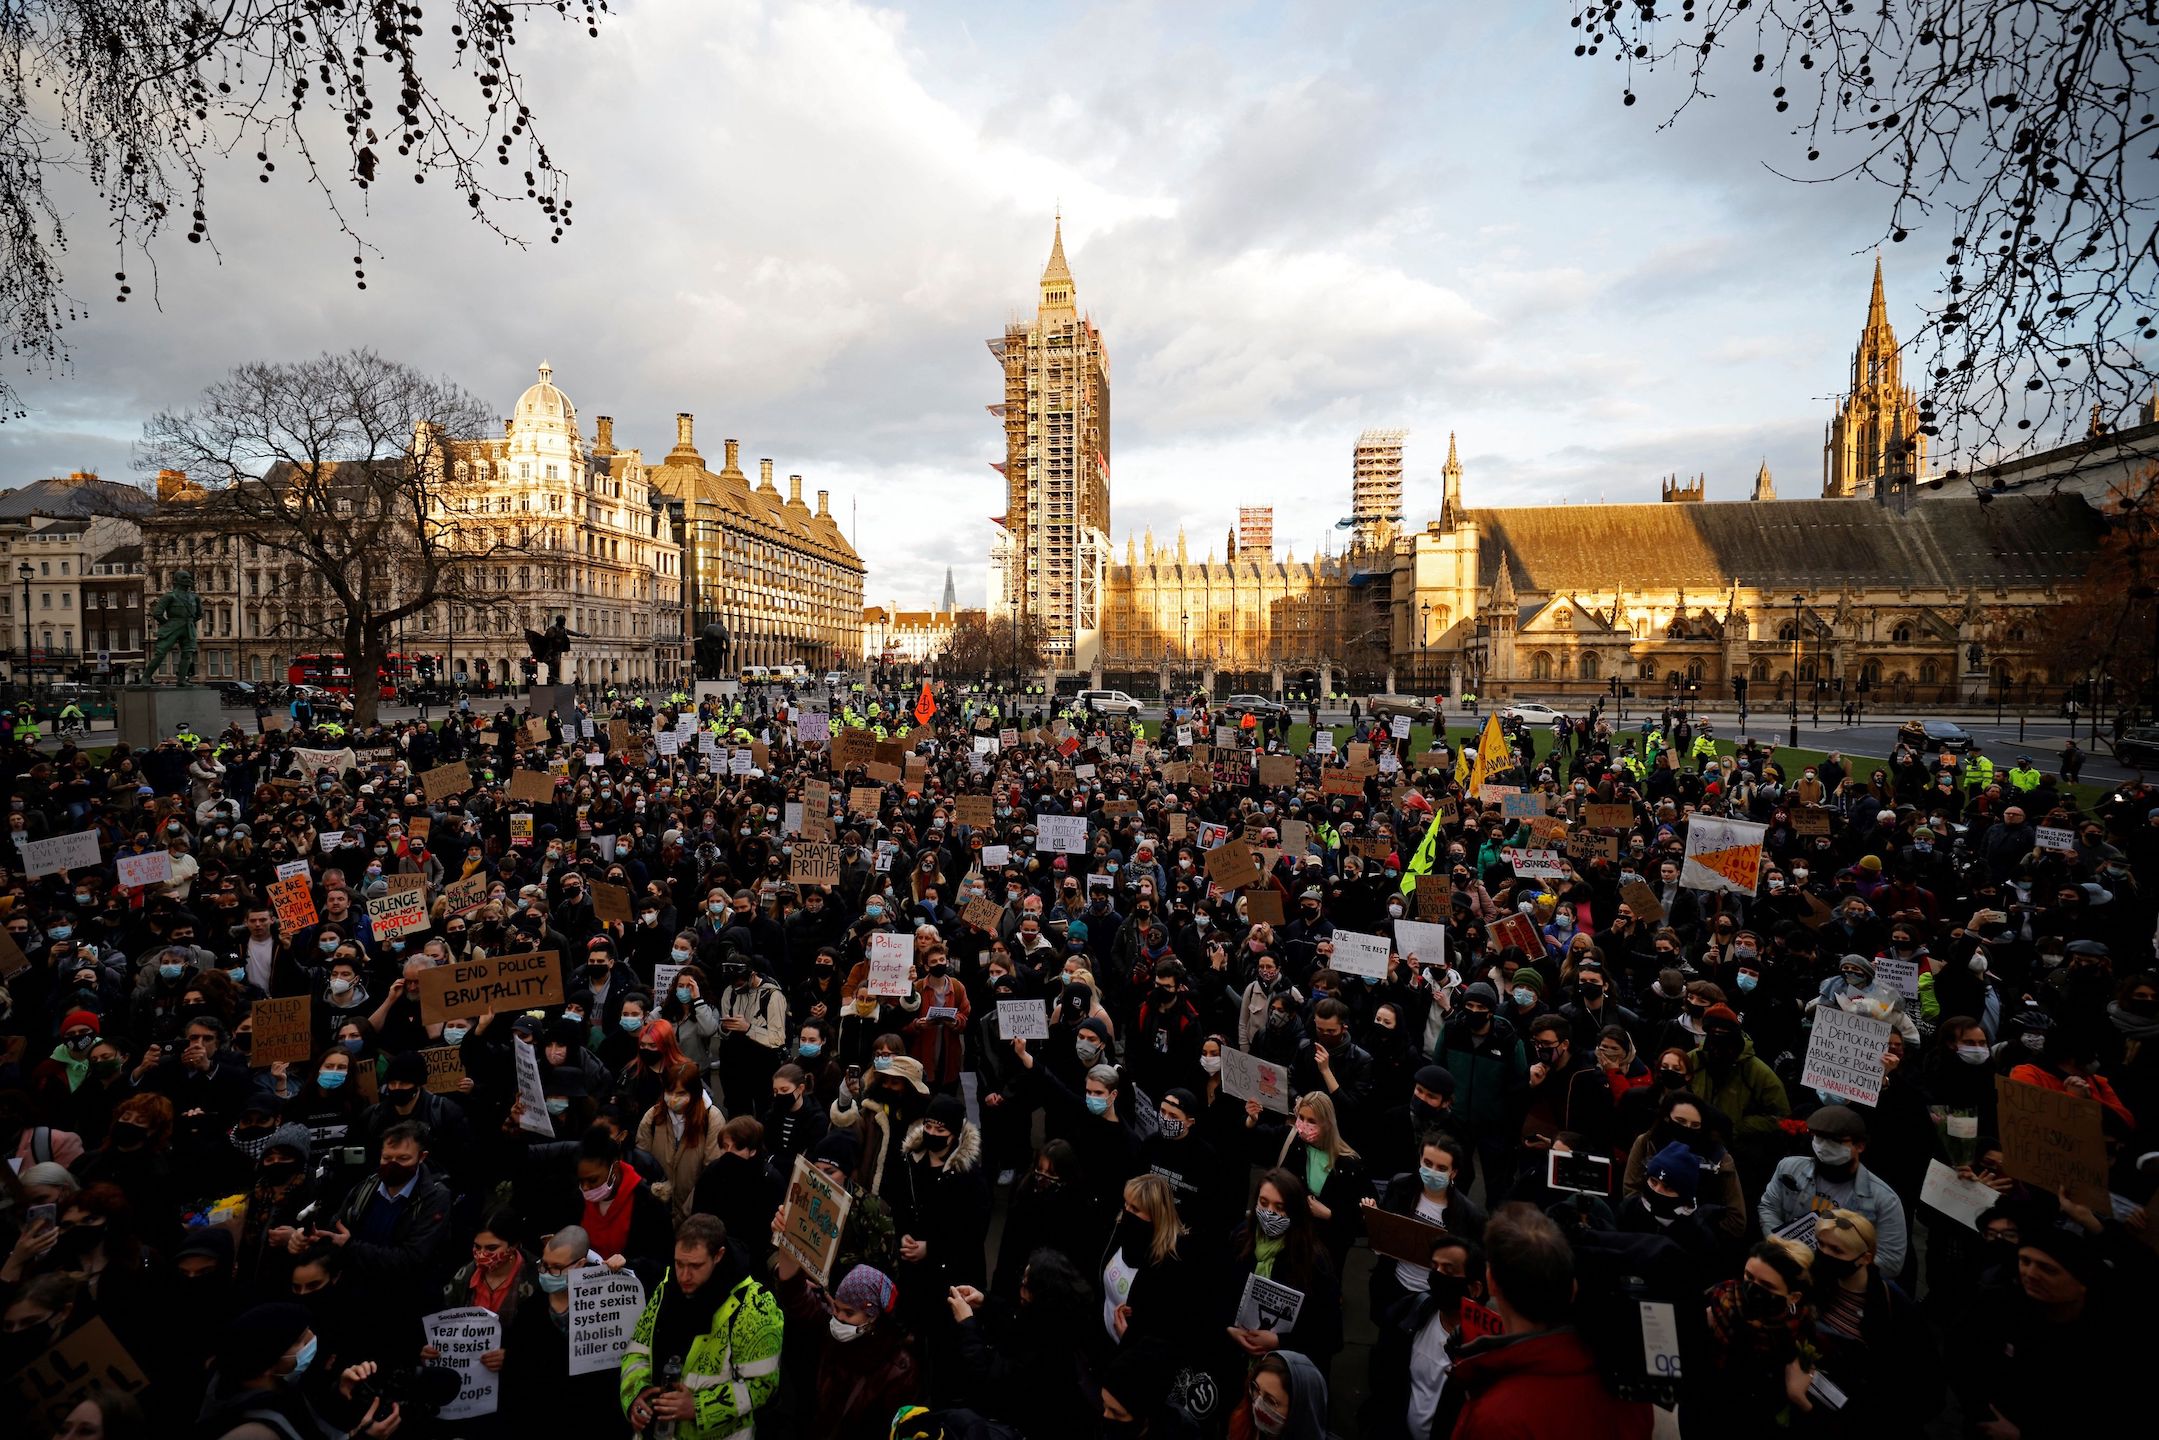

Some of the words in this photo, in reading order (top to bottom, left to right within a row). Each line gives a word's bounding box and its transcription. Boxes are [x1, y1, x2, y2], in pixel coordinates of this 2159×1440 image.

[799, 714, 829, 724] POLICE
[801, 725, 822, 734] YOUR
[303, 752, 337, 761] WHERE
[1215, 748, 1228, 760] I'M
[1229, 750, 1250, 763] WITH
[426, 766, 457, 781] RACIST
[1224, 761, 1243, 775] HER
[1072, 817, 1084, 826] YOU
[1596, 806, 1626, 823] 97%
[1051, 827, 1077, 836] PROTECT
[2037, 834, 2071, 843] DEMOCRACY
[1053, 839, 1066, 847] KILL
[1069, 840, 1079, 848] US
[1572, 834, 1606, 845] SEXISM
[793, 843, 838, 862] SHAME
[1512, 850, 1518, 858] A
[1526, 850, 1533, 858] C
[1542, 851, 1549, 859] A
[1572, 845, 1609, 858] PANDEMIC
[1728, 844, 1759, 857] STAY
[147, 855, 166, 863] TIRED
[1726, 857, 1756, 873] LOUD
[793, 860, 825, 877] PRITI
[147, 872, 163, 880] FEAR
[388, 875, 425, 889] ENOUGH
[1419, 877, 1441, 887] MALE
[1720, 866, 1753, 890] SISTA
[270, 884, 283, 895] WE
[286, 880, 302, 890] ARE
[1418, 886, 1449, 895] VIOLENCE
[293, 892, 306, 900] TO
[370, 892, 417, 916] SILENCE
[970, 902, 981, 911] DO
[982, 908, 996, 919] NOT
[974, 895, 999, 912] POLICE
[1419, 904, 1450, 915] PROBLEM
[280, 904, 302, 919] DEATH
[380, 912, 397, 921] WILL
[401, 906, 417, 915] NOT
[296, 912, 317, 927] SHIT
[372, 912, 423, 932] PROTECT
[384, 926, 403, 938] US!
[1334, 932, 1349, 942] ONE
[876, 935, 902, 949] Police
[1361, 944, 1371, 952] THE
[1372, 946, 1388, 955] REST
[455, 967, 488, 982] END
[499, 957, 545, 977] POLICE
[872, 960, 902, 971] Protect
[1895, 963, 1914, 971] down
[1877, 973, 1902, 981] system
[444, 976, 548, 1007] BRUTALITY
[256, 1000, 301, 1015] KILLED
[1000, 1002, 1027, 1012] PROTEST
[1029, 1002, 1036, 1010] IS
[1038, 1002, 1043, 1010] A
[257, 1015, 272, 1026] BY
[278, 1012, 296, 1024] THE
[1008, 1014, 1035, 1024] HUMAN
[1819, 1007, 1843, 1026] YOU
[1848, 1016, 1872, 1033] CALL
[1874, 1023, 1890, 1037] THIS
[256, 1022, 305, 1038] SYSTEM
[1012, 1025, 1033, 1035] RIGHT
[1815, 1022, 1823, 1033] A
[292, 1032, 310, 1043] TOLD
[1812, 1035, 1834, 1049] THIS
[1840, 1045, 1849, 1054] IS
[1853, 1048, 1877, 1061] THE
[1808, 1047, 1837, 1061] ABUSE
[1839, 1057, 1852, 1065] OF
[1853, 1059, 1883, 1074] POWER
[426, 1061, 463, 1076] OMEN!
[1807, 1059, 1848, 1079] AGAINST
[1225, 1068, 1249, 1091] AB
[1807, 1073, 1821, 1084] RIP
[1821, 1077, 1843, 1092] SARAH
[1844, 1085, 1877, 1102] EVERARD
[2003, 1081, 2048, 1113] RISE
[2006, 1133, 2034, 1162] THE
[806, 1170, 832, 1200] Sounds
[582, 1270, 610, 1280] Socialist
[574, 1286, 603, 1297] Tear
[607, 1281, 639, 1293] down
[574, 1300, 595, 1311] the
[600, 1295, 637, 1308] sexist
[438, 1313, 466, 1321] Socialist
[574, 1311, 620, 1327] system
[431, 1325, 459, 1337] Tear
[462, 1325, 495, 1337] down
[574, 1325, 622, 1343] Abolish
[432, 1339, 449, 1352] the
[453, 1338, 490, 1353] sexist
[574, 1343, 608, 1357] killer
[612, 1341, 630, 1351] co
[429, 1355, 470, 1368] system
[460, 1385, 492, 1401] cops
